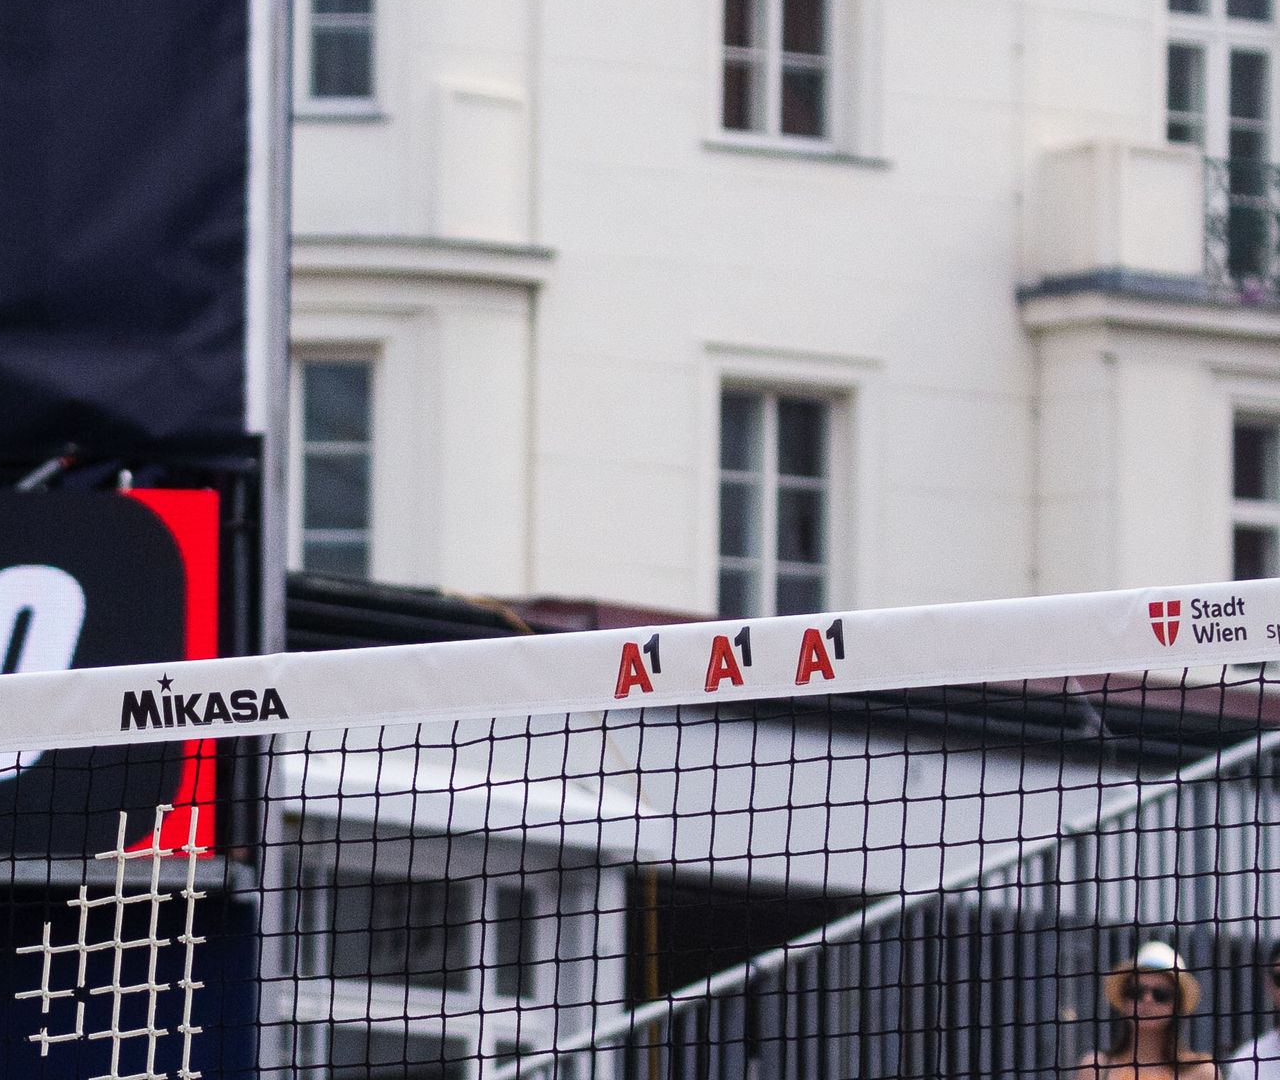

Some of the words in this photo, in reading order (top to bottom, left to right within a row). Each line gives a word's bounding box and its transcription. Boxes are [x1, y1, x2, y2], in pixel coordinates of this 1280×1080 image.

[1191, 596, 1245, 619] Stadt
[1192, 622, 1247, 644] Wien
[614, 633, 661, 699] A1
[704, 626, 752, 692] A1
[795, 619, 844, 685] A1
